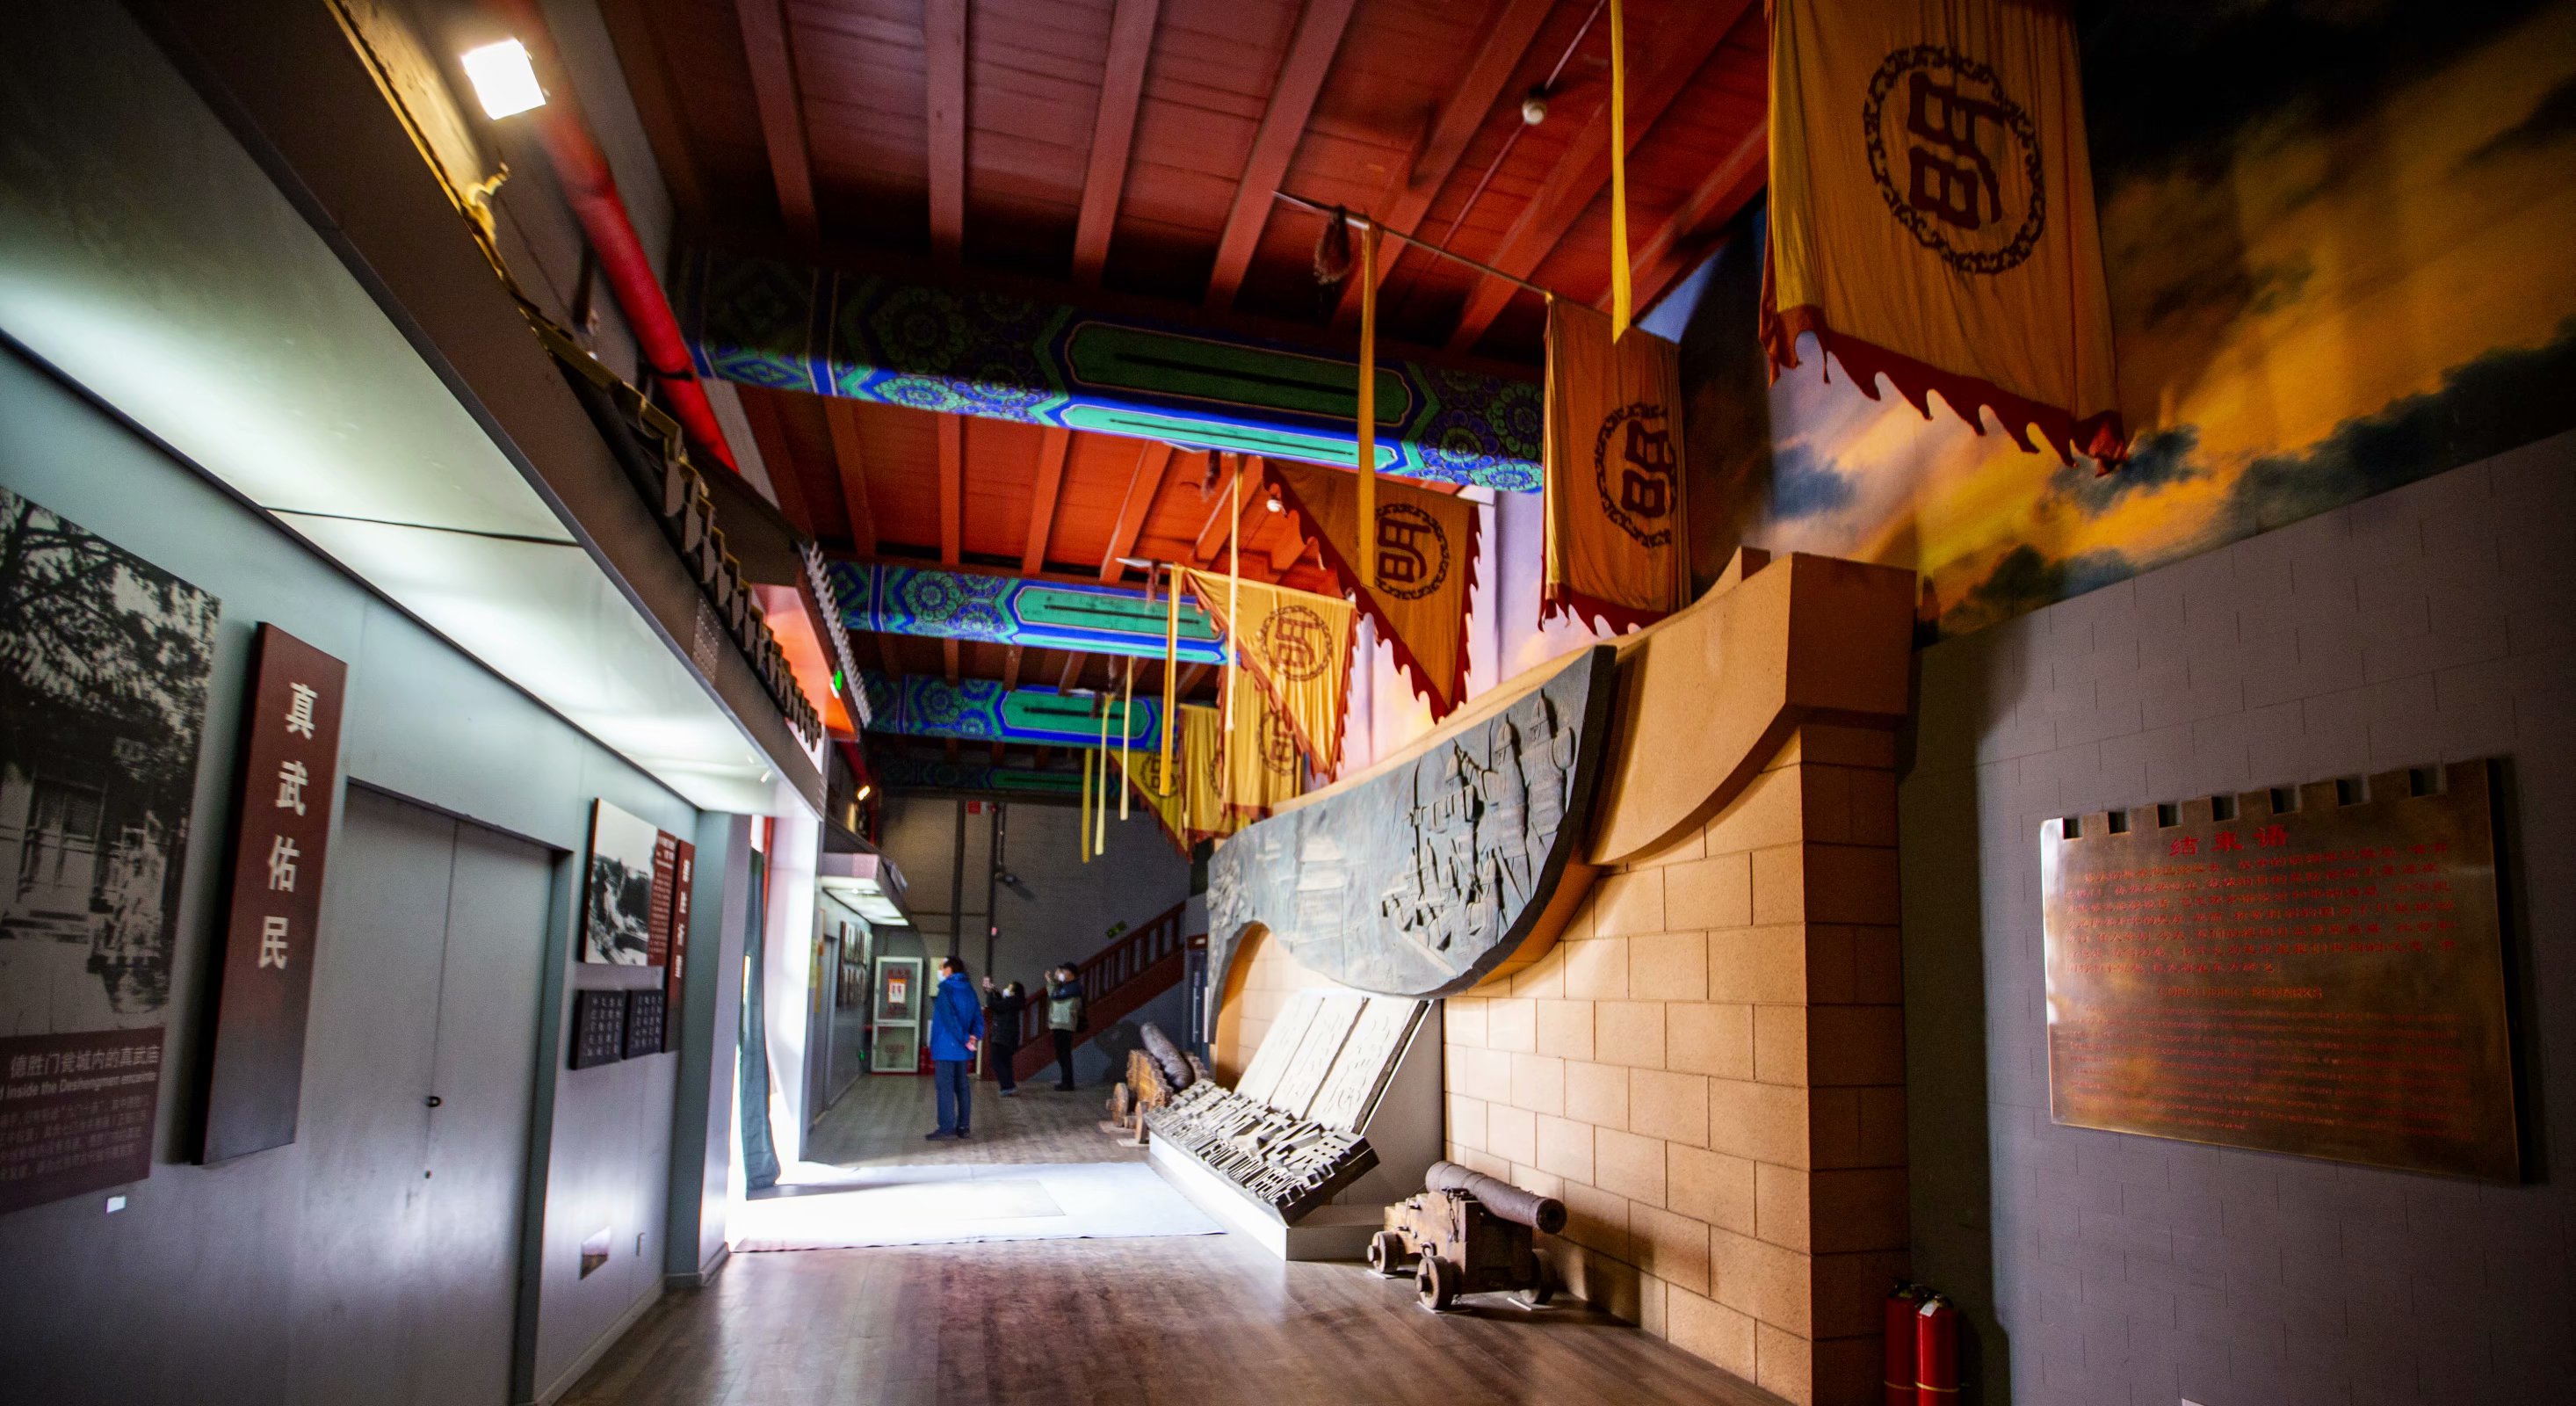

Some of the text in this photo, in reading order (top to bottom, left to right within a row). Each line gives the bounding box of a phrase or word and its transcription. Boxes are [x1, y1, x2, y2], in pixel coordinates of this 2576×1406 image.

[1907, 72, 2005, 230] 明
[257, 681, 318, 970] 真武佑民
[2168, 823, 2290, 857] 结束语
[2252, 986, 2323, 999] REMARKS
